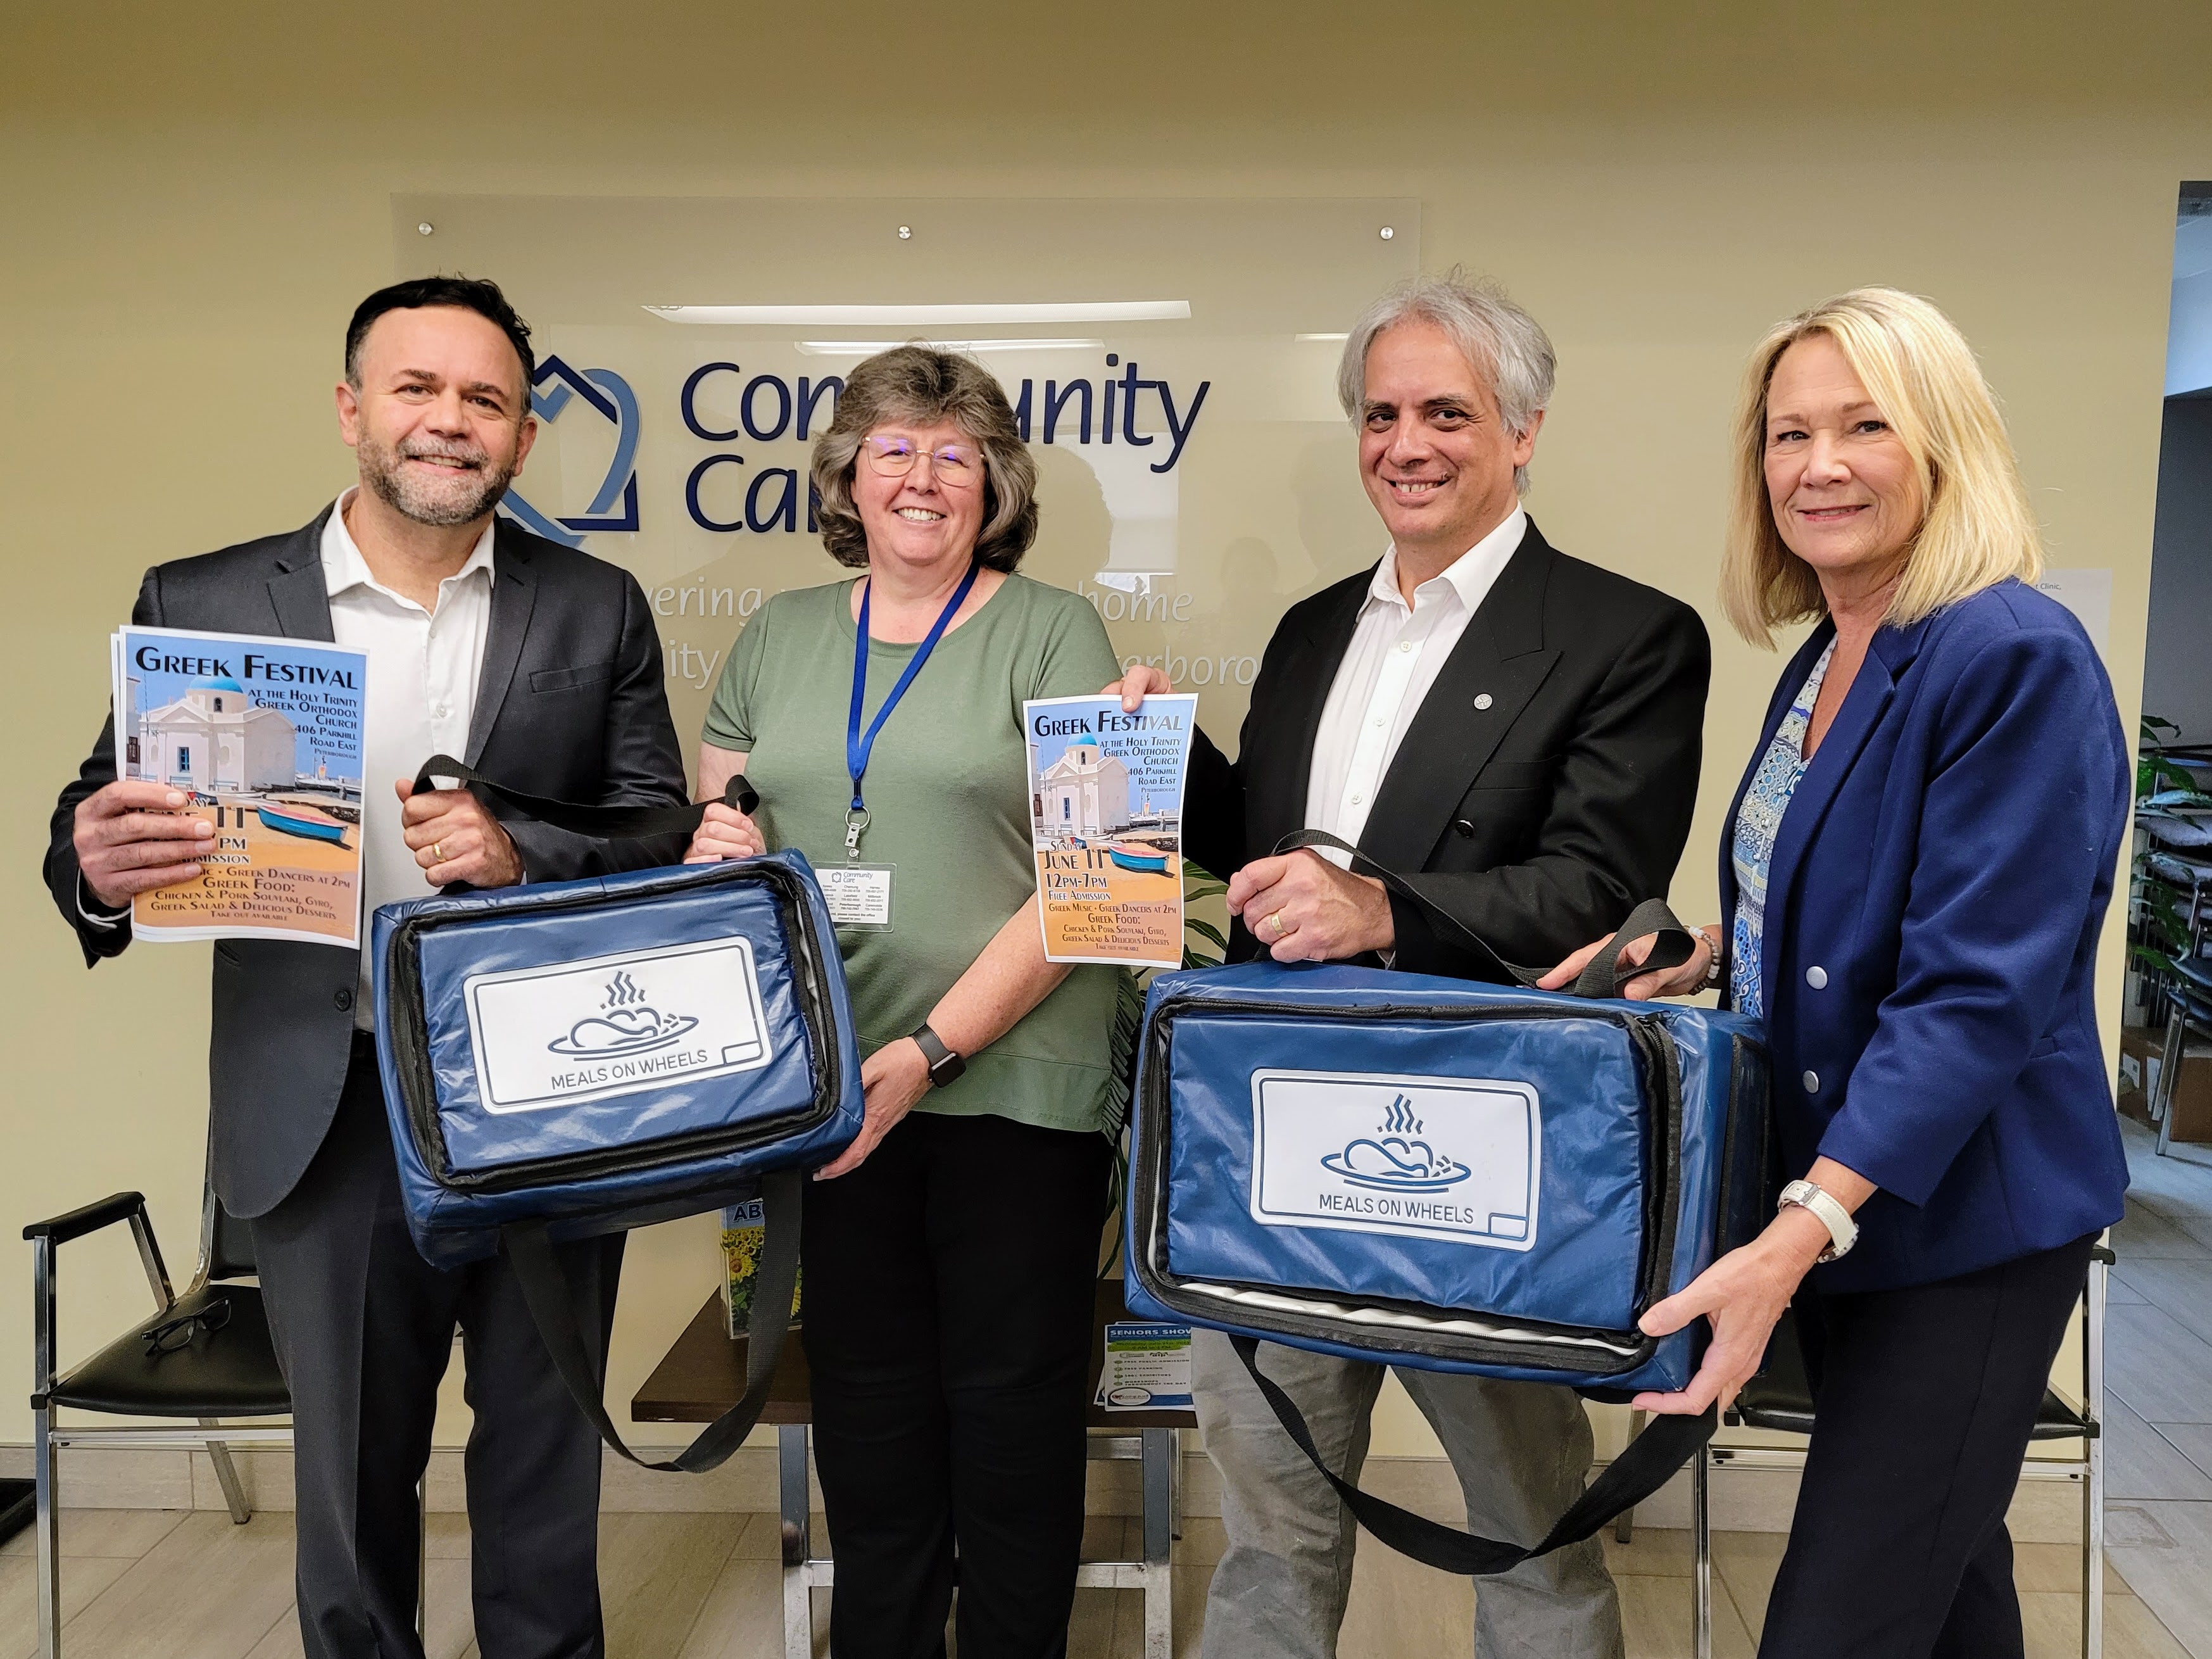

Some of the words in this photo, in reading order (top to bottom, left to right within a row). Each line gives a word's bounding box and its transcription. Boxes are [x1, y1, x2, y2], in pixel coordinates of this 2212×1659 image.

[135, 647, 233, 678] GREEK
[244, 654, 358, 690] FESTIVAL
[267, 690, 286, 698] THE
[290, 690, 319, 702] HOLY
[323, 693, 358, 707] TRINITY
[255, 698, 295, 710] GREEK
[299, 702, 357, 718] ORTHODOX
[316, 714, 357, 729] CHURCH
[1034, 715, 1091, 736] GREEK
[1098, 710, 1183, 732] FESTIVAL
[294, 725, 316, 735] 406
[320, 728, 357, 740] PARKHILL
[310, 737, 334, 747] ROAD
[338, 741, 357, 750] EAST
[1100, 740, 1108, 748] AT
[1126, 737, 1148, 747] HOLY
[1151, 736, 1182, 746] TRINITY
[1104, 748, 1129, 757] GREEK
[1132, 747, 1180, 756] ORTHODOX
[1143, 756, 1178, 766] CHURCH
[1128, 767, 1143, 776] 406
[1051, 841, 1083, 852] SUNDAY
[1044, 850, 1079, 869] JUNE
[1085, 849, 1103, 869] 11
[227, 867, 264, 877] GREEK
[268, 869, 315, 882] DANCERS
[332, 876, 350, 888] 2PM
[843, 871, 873, 880] Community
[203, 877, 249, 889] GREEK
[254, 879, 296, 893] FOOD:
[155, 890, 201, 900] CHICKEN
[206, 890, 215, 899] &
[220, 890, 249, 900] PORK
[1048, 890, 1067, 900] FREE
[1070, 890, 1111, 900] ADMISSION
[151, 902, 187, 911] GREEK
[191, 902, 225, 910] SALAD
[242, 902, 292, 913] DELICIOUS
[296, 905, 337, 919] DESSERTS
[1049, 903, 1071, 912] GREEK
[1072, 903, 1093, 912] MUSIC
[1099, 904, 1121, 912] GREEK
[1122, 904, 1152, 913] DANCERS
[1163, 904, 1176, 914] 2PM
[1088, 913, 1114, 924] GREEK
[1115, 914, 1140, 924] FOOD:
[1064, 924, 1089, 933] CHICKEN
[1098, 925, 1115, 933] PORK
[1062, 934, 1083, 942] GREEK
[1084, 934, 1103, 942] SALAD
[1105, 935, 1110, 943] &
[551, 1068, 608, 1090] MEALS
[612, 1062, 636, 1079] ON
[638, 1050, 708, 1075] WHEELS
[1319, 1194, 1374, 1213] MEALS
[1378, 1199, 1400, 1216] ON
[1405, 1203, 1474, 1224] WHEELS
